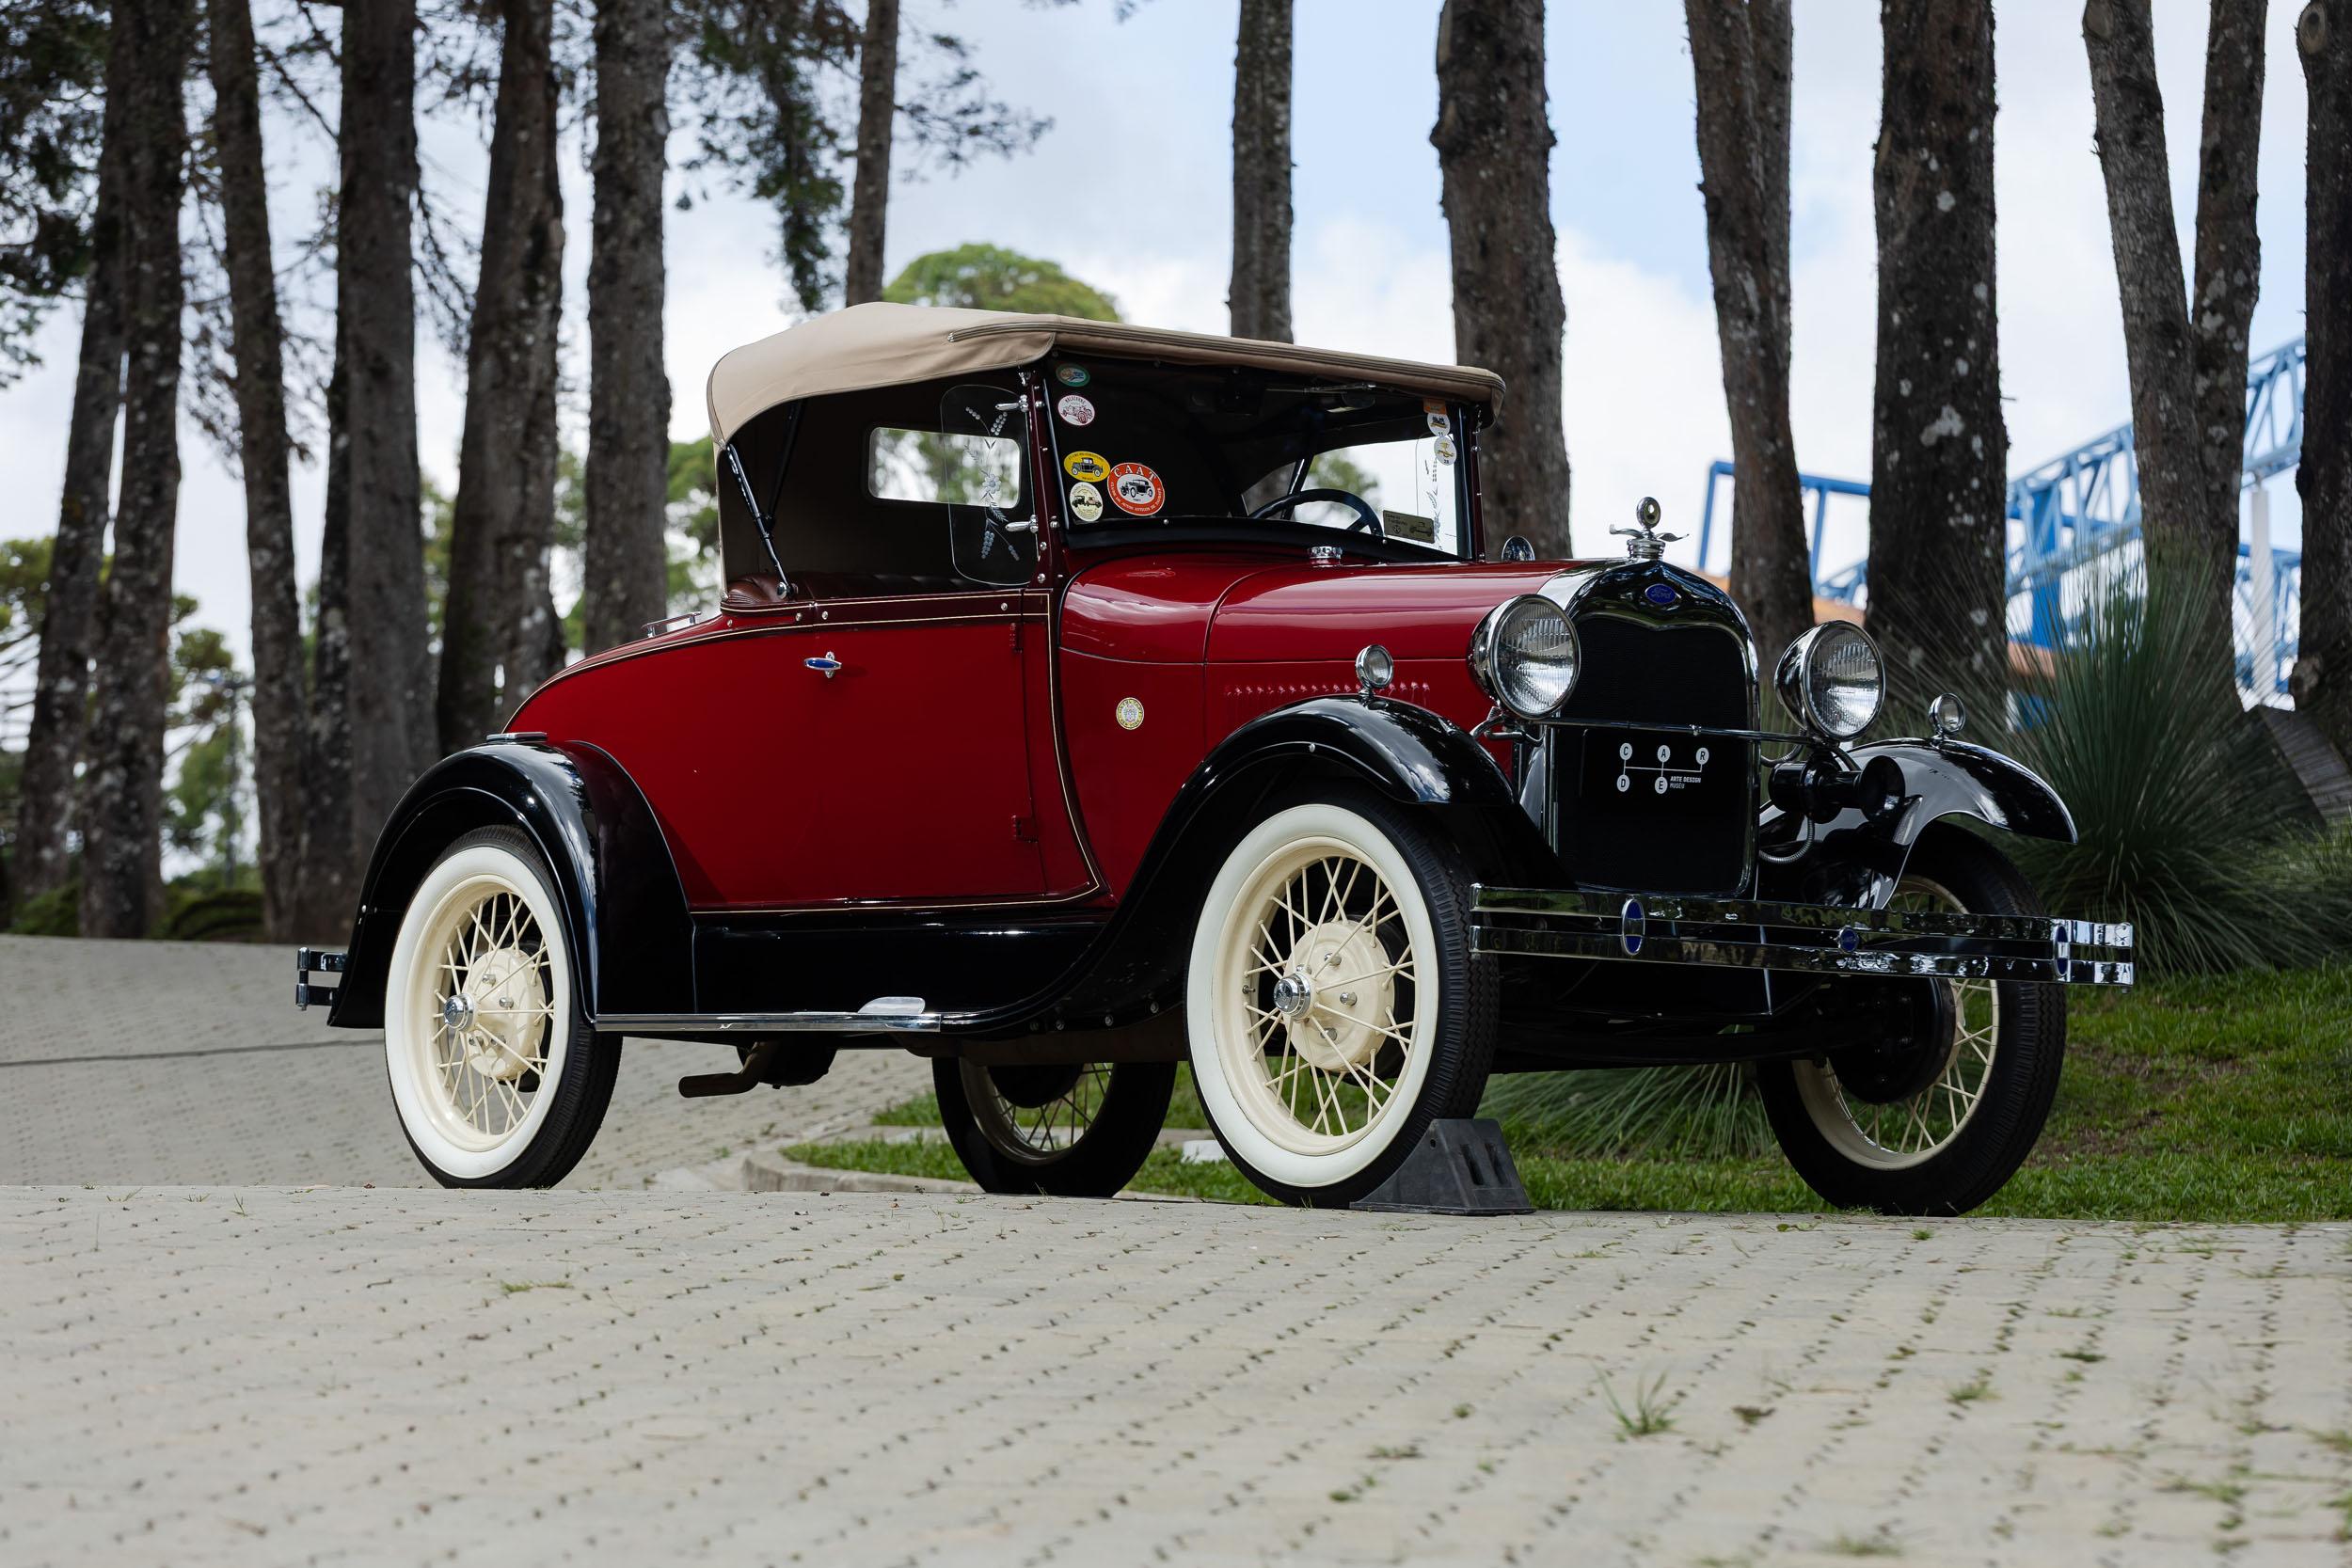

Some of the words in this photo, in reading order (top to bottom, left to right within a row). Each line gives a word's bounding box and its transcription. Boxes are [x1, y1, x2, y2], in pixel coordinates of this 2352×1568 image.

[1114, 465, 1155, 481] CAAT
[1650, 587, 1672, 599] Ford
[1623, 747, 1629, 755] C
[1661, 749, 1666, 758] A
[1700, 751, 1706, 760] R
[1620, 779, 1626, 788] D
[1659, 781, 1664, 790] E
